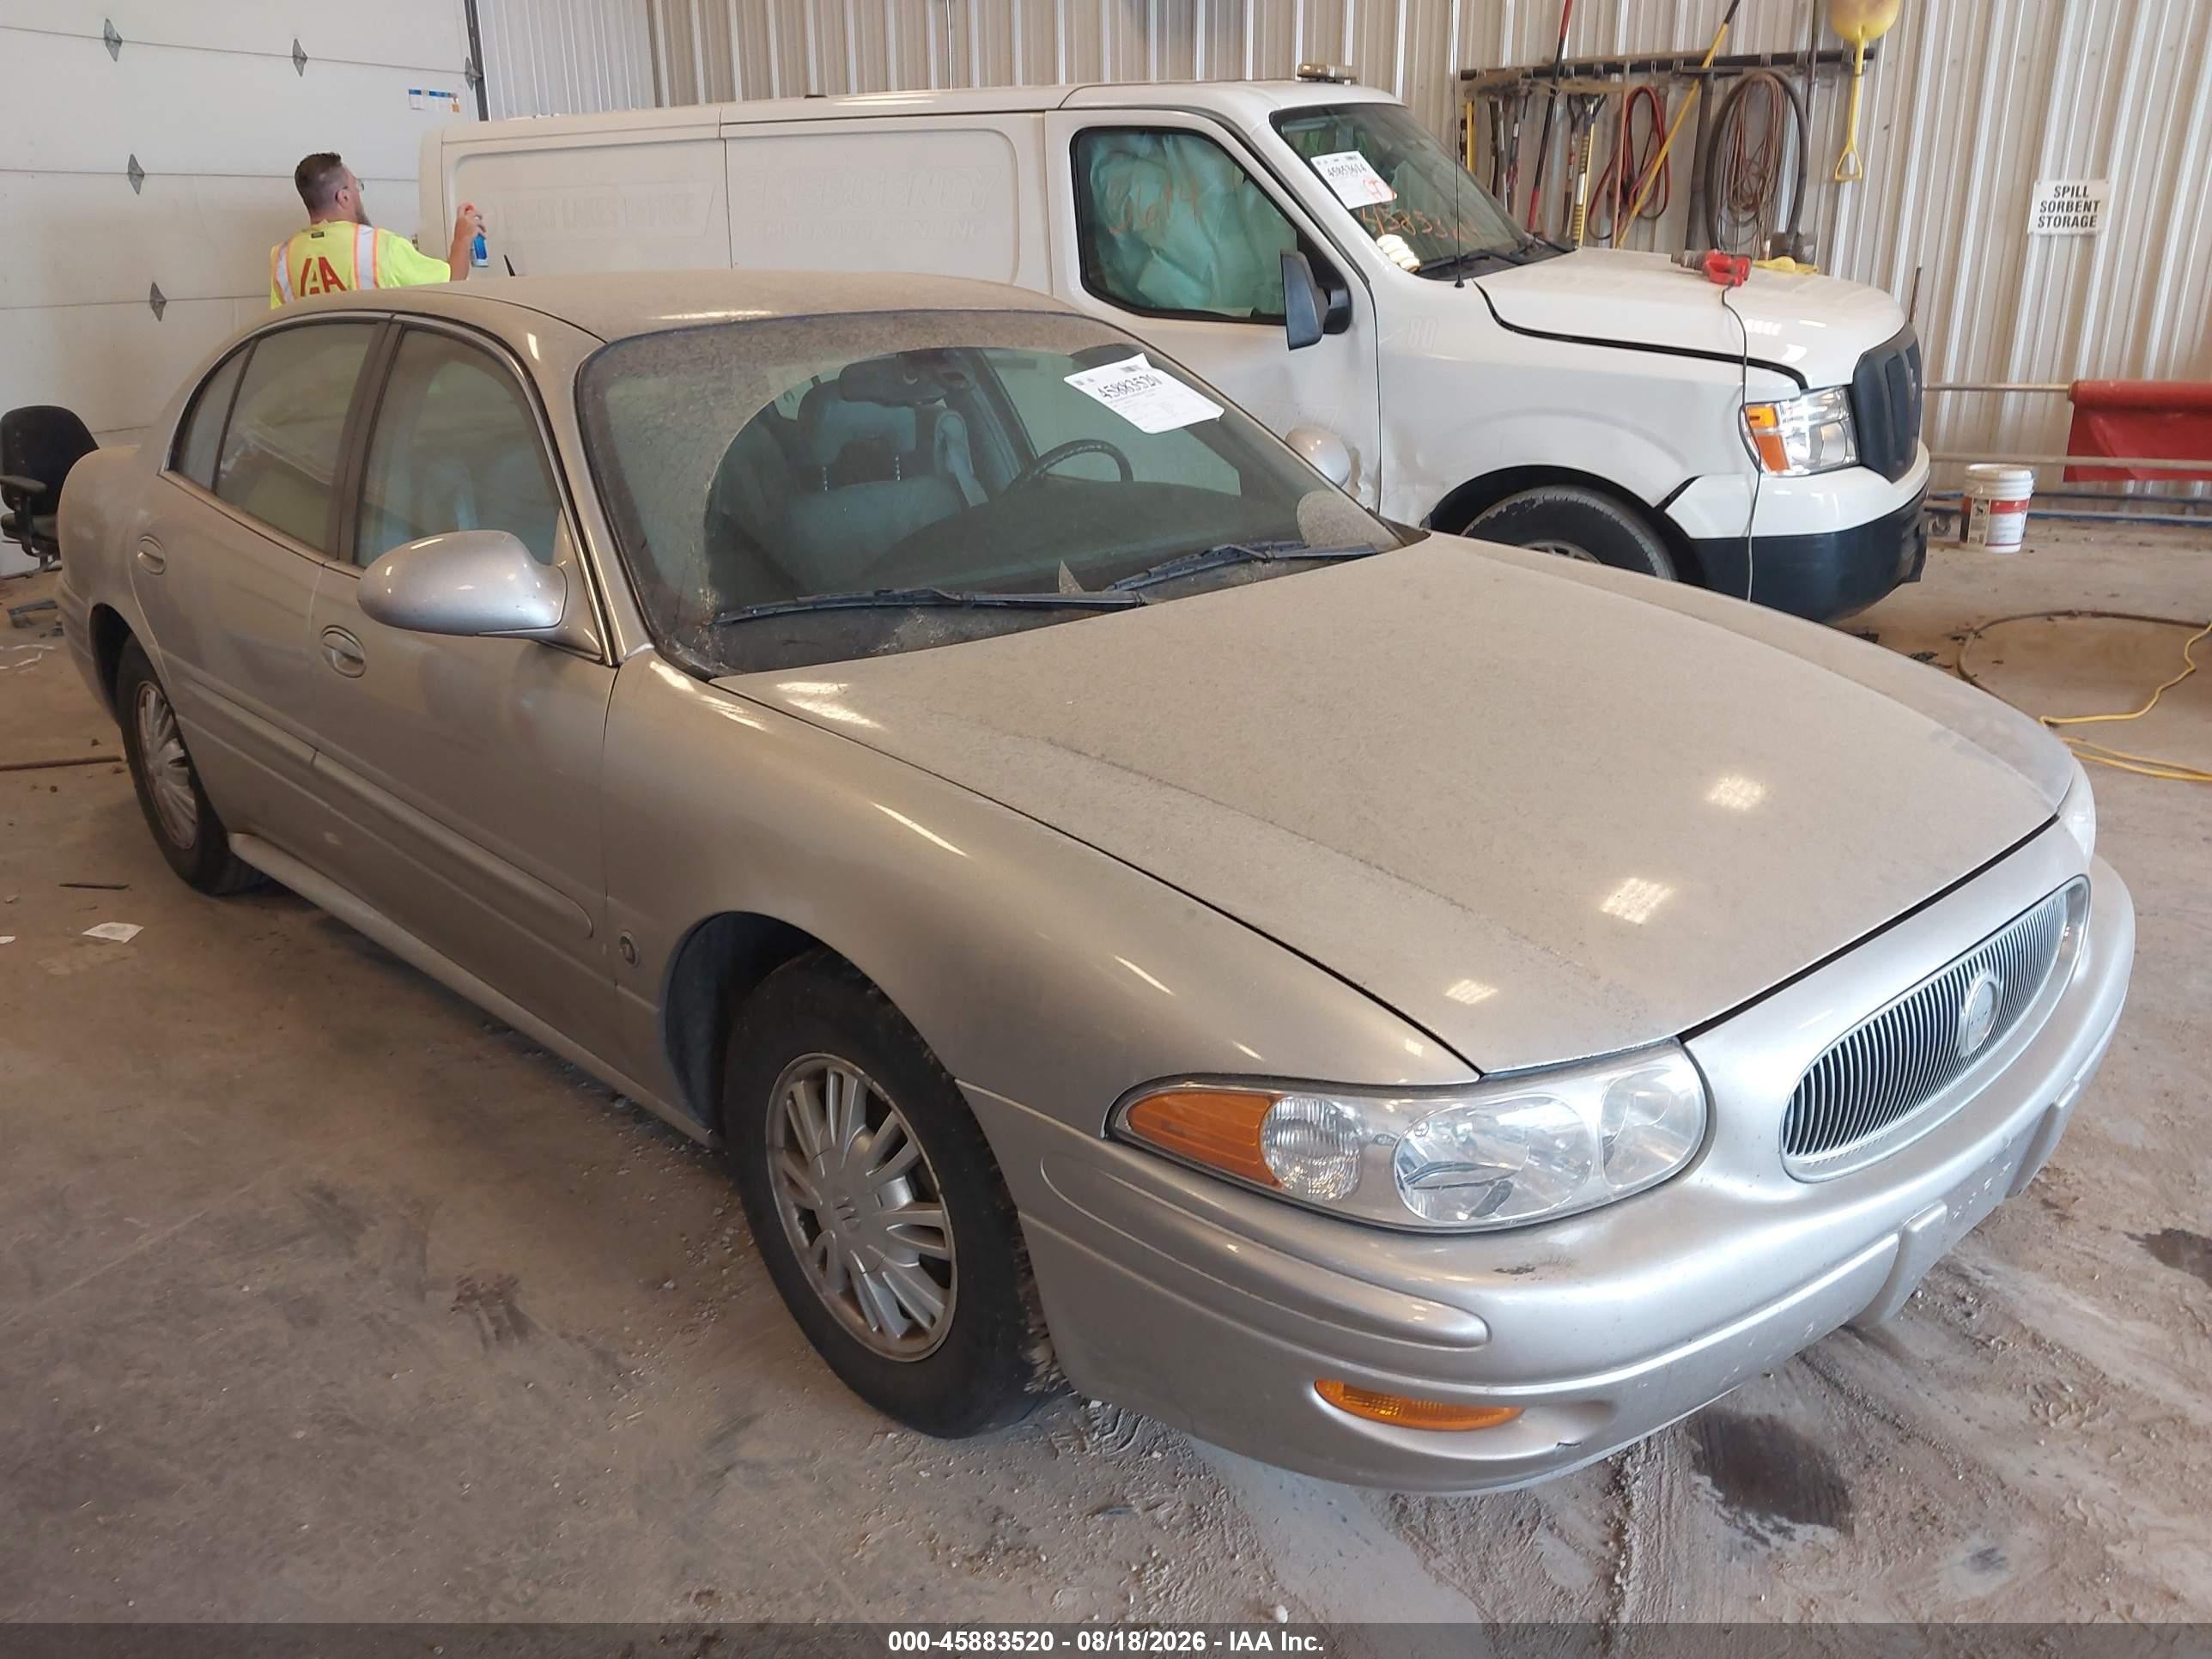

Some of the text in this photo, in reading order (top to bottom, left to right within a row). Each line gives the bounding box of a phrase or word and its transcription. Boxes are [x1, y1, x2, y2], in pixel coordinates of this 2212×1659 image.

[2053, 185, 2089, 198] SPILL
[2039, 199, 2101, 214] SORBENT
[2037, 215, 2098, 228] STORAGE
[1097, 374, 1163, 399] 45883520
